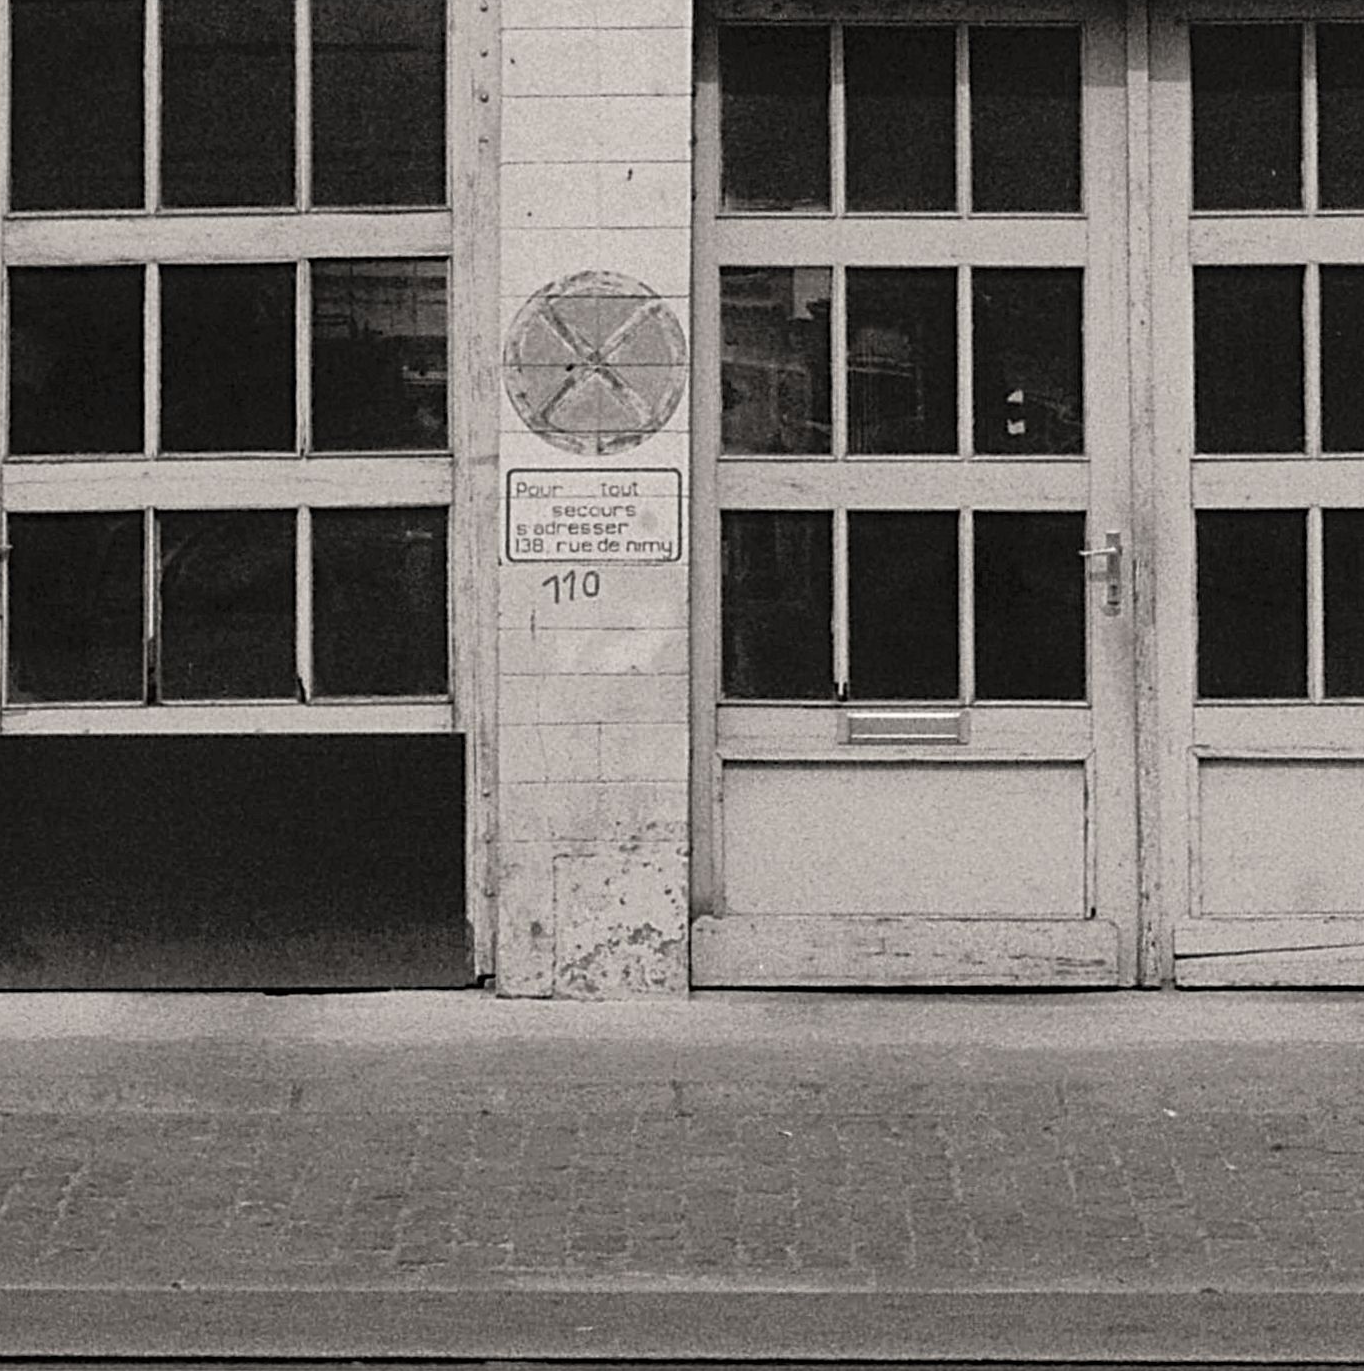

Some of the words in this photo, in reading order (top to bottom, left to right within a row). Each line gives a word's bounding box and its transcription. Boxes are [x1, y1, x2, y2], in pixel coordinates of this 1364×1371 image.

[516, 481, 564, 498] Pour
[600, 481, 640, 497] tout
[551, 504, 638, 518] secours
[555, 540, 593, 553] rue
[596, 537, 621, 553] de
[542, 569, 600, 605] 110
